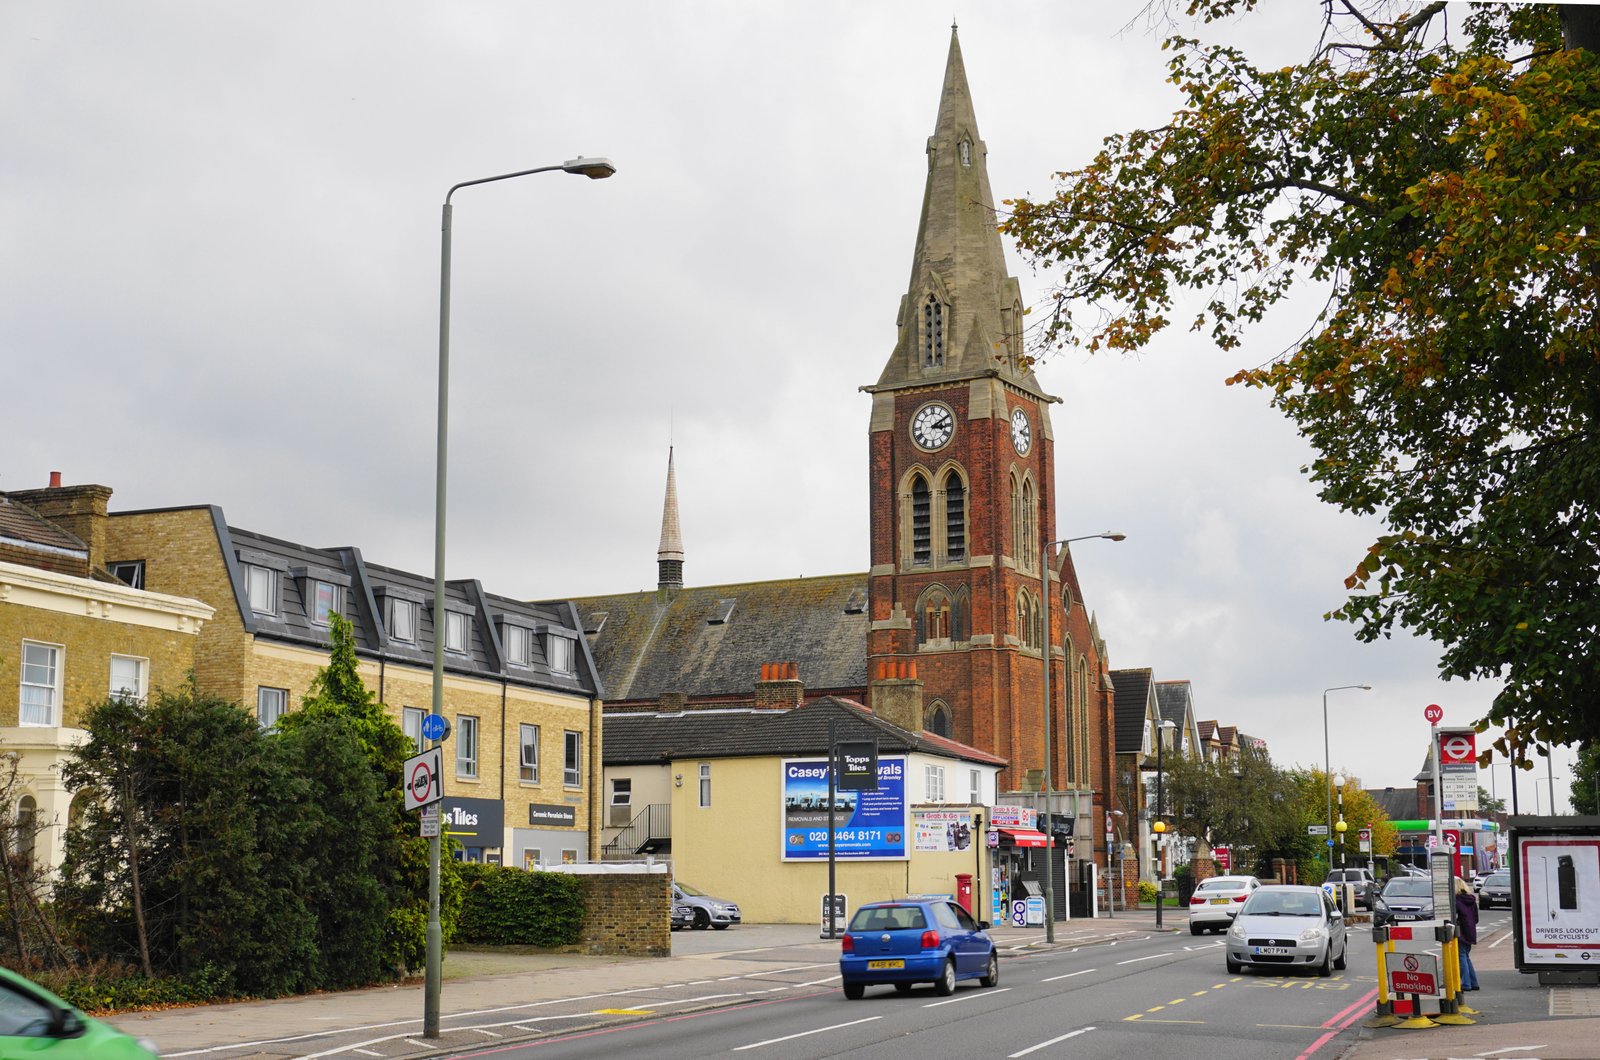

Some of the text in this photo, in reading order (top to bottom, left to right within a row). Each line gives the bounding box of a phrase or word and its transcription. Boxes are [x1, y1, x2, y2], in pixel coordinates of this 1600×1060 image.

[1427, 710, 1441, 719] BV
[844, 755, 870, 765] Topps
[848, 764, 867, 772] Tiles
[877, 763, 902, 775] vals
[453, 807, 478, 826] Tiles
[533, 810, 573, 820] Ceramic Porcelain Stone
[809, 832, 828, 842] 020
[858, 831, 881, 840] 8171
[1406, 973, 1419, 981] No
[1395, 982, 1432, 993] smoking
